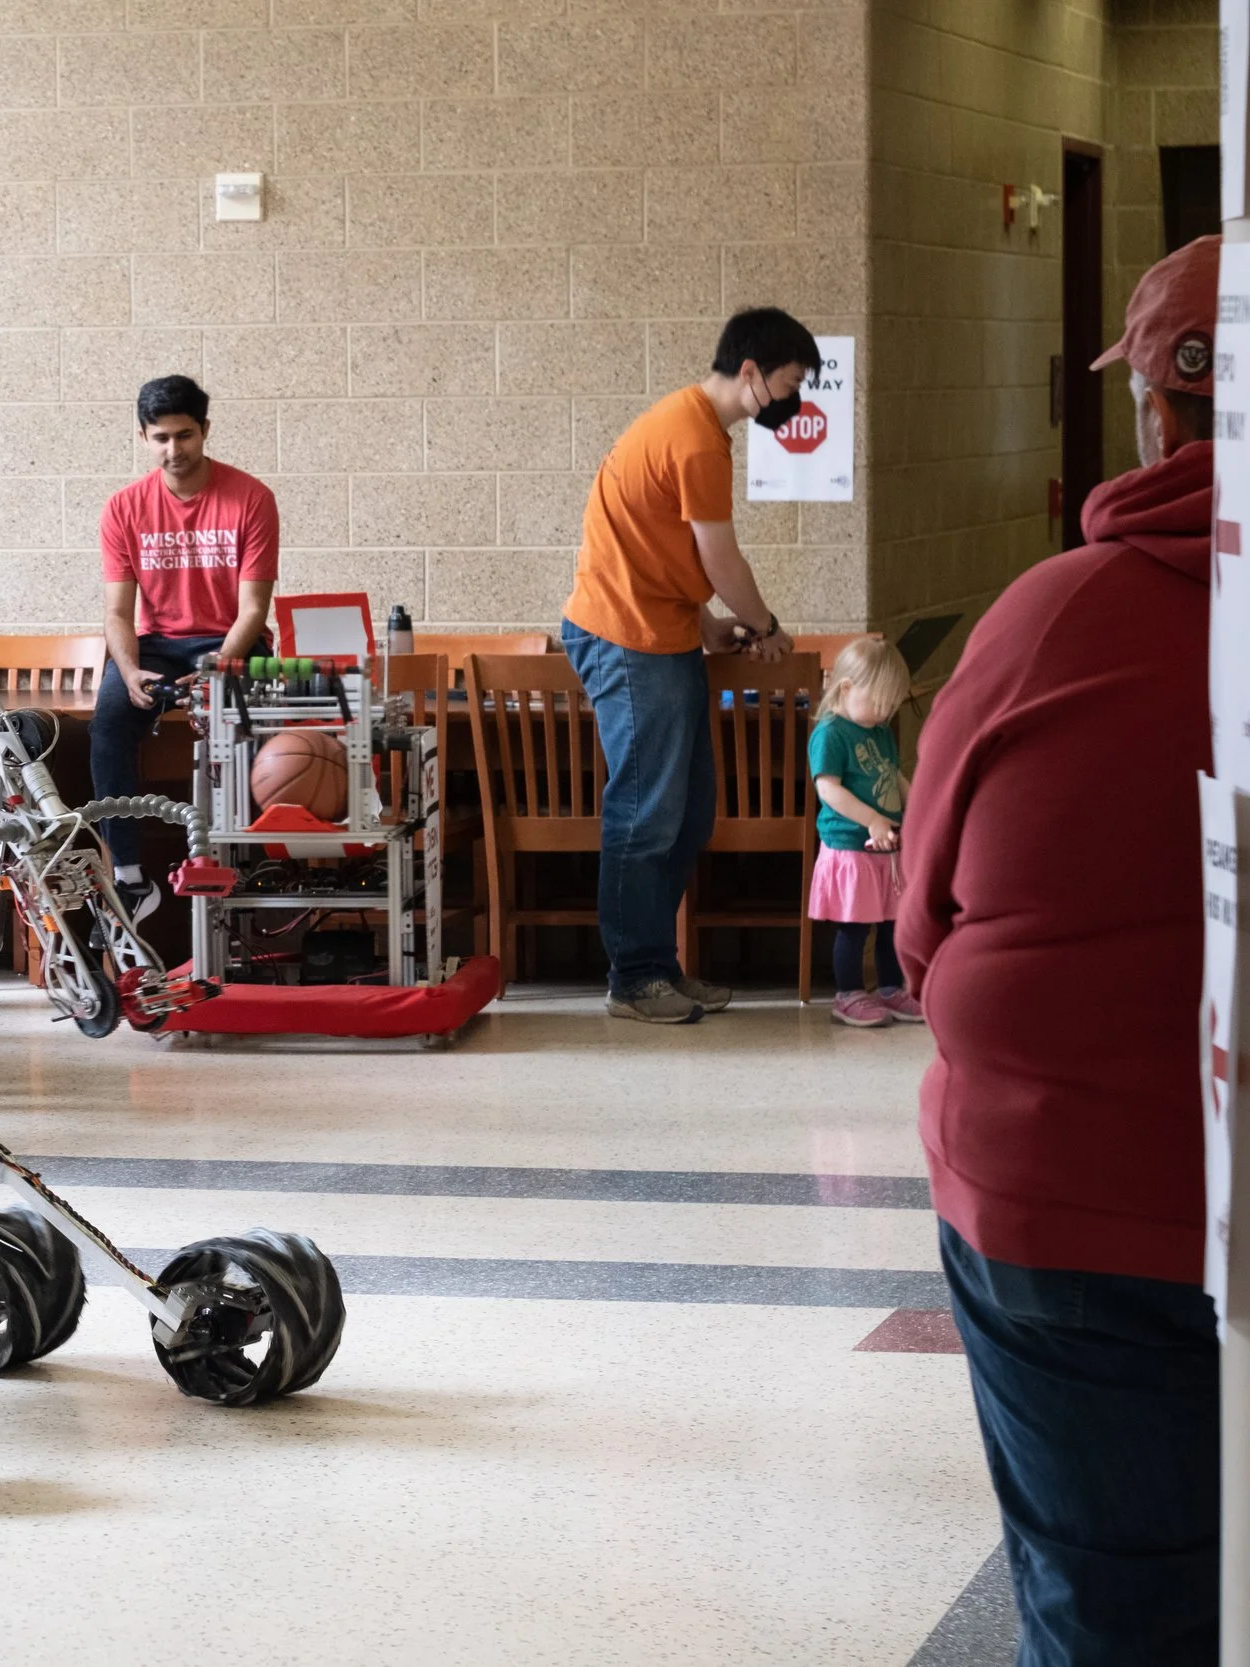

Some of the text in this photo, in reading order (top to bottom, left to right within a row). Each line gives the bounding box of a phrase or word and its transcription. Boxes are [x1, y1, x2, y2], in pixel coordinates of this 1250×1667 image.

[807, 379, 843, 391] WAY
[776, 414, 825, 440] STOP
[140, 529, 238, 548] WISCONSIN
[141, 554, 238, 571] ENGINEERING
